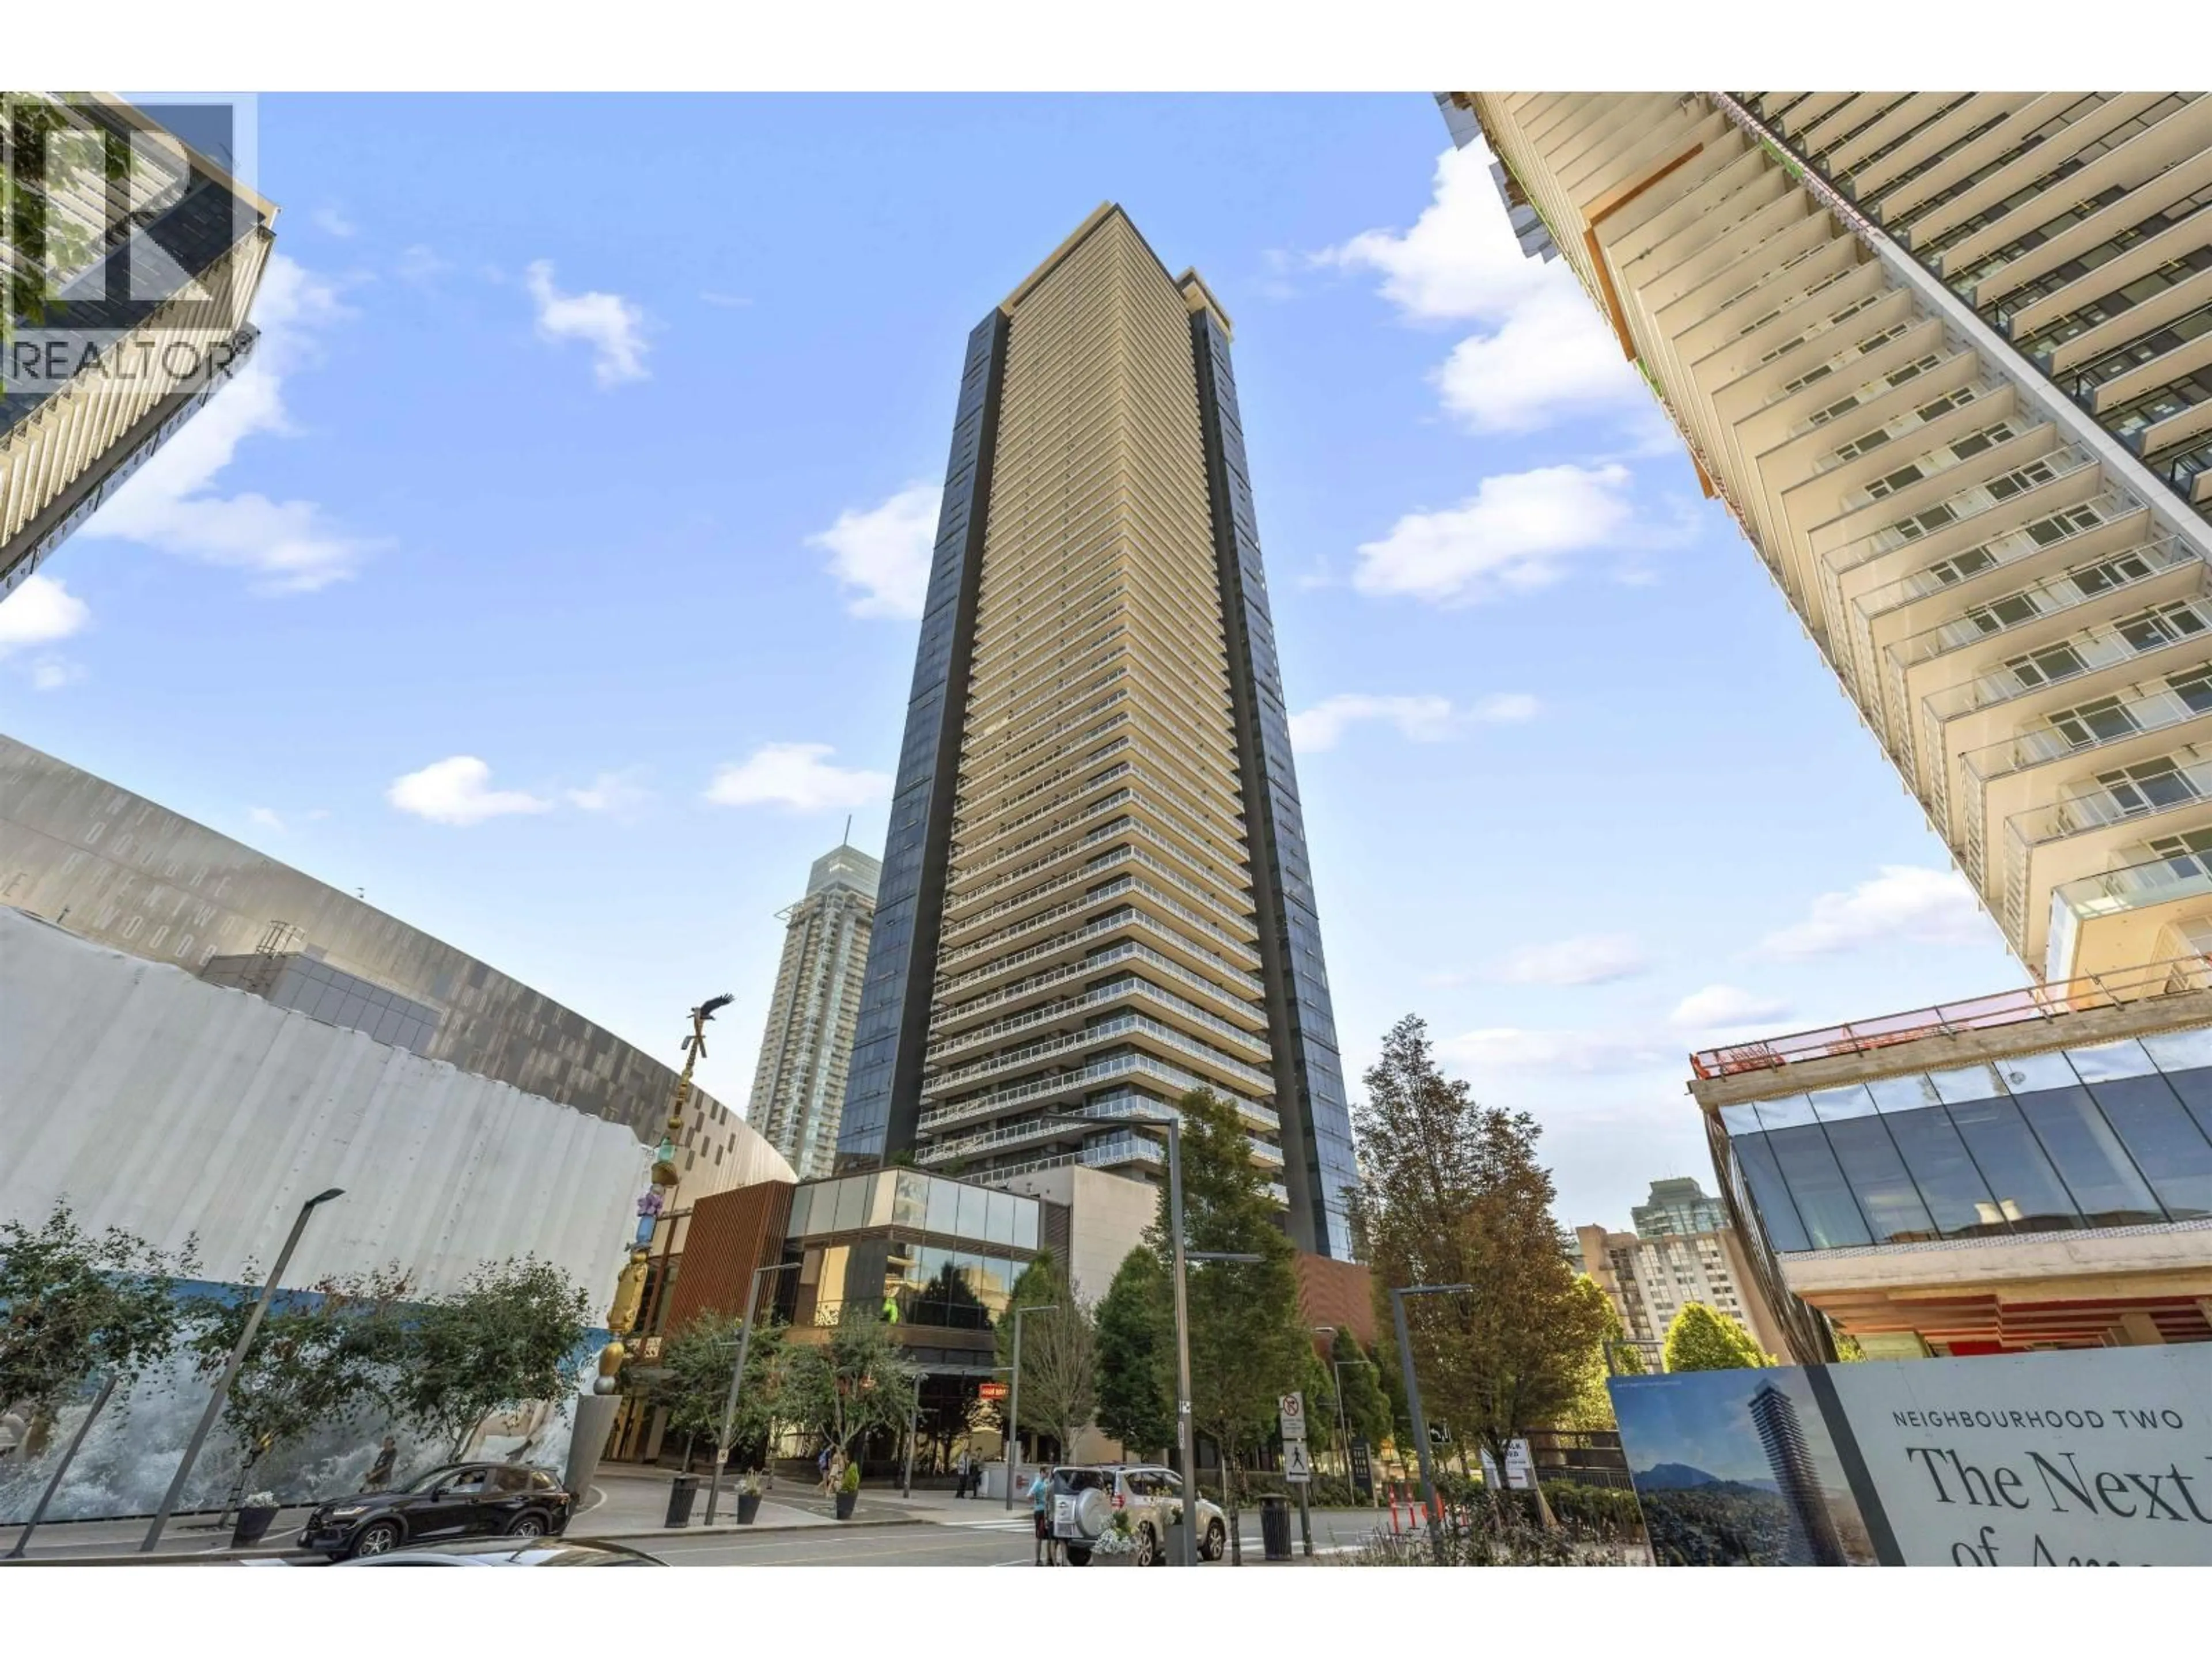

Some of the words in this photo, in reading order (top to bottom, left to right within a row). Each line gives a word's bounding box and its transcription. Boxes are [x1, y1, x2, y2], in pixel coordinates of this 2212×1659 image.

[1892, 1410, 2104, 1428] NEIGHBOURHOOD
[2112, 1410, 2183, 1429] TWO
[1906, 1447, 2029, 1509] The
[2024, 1451, 2212, 1524] Next
